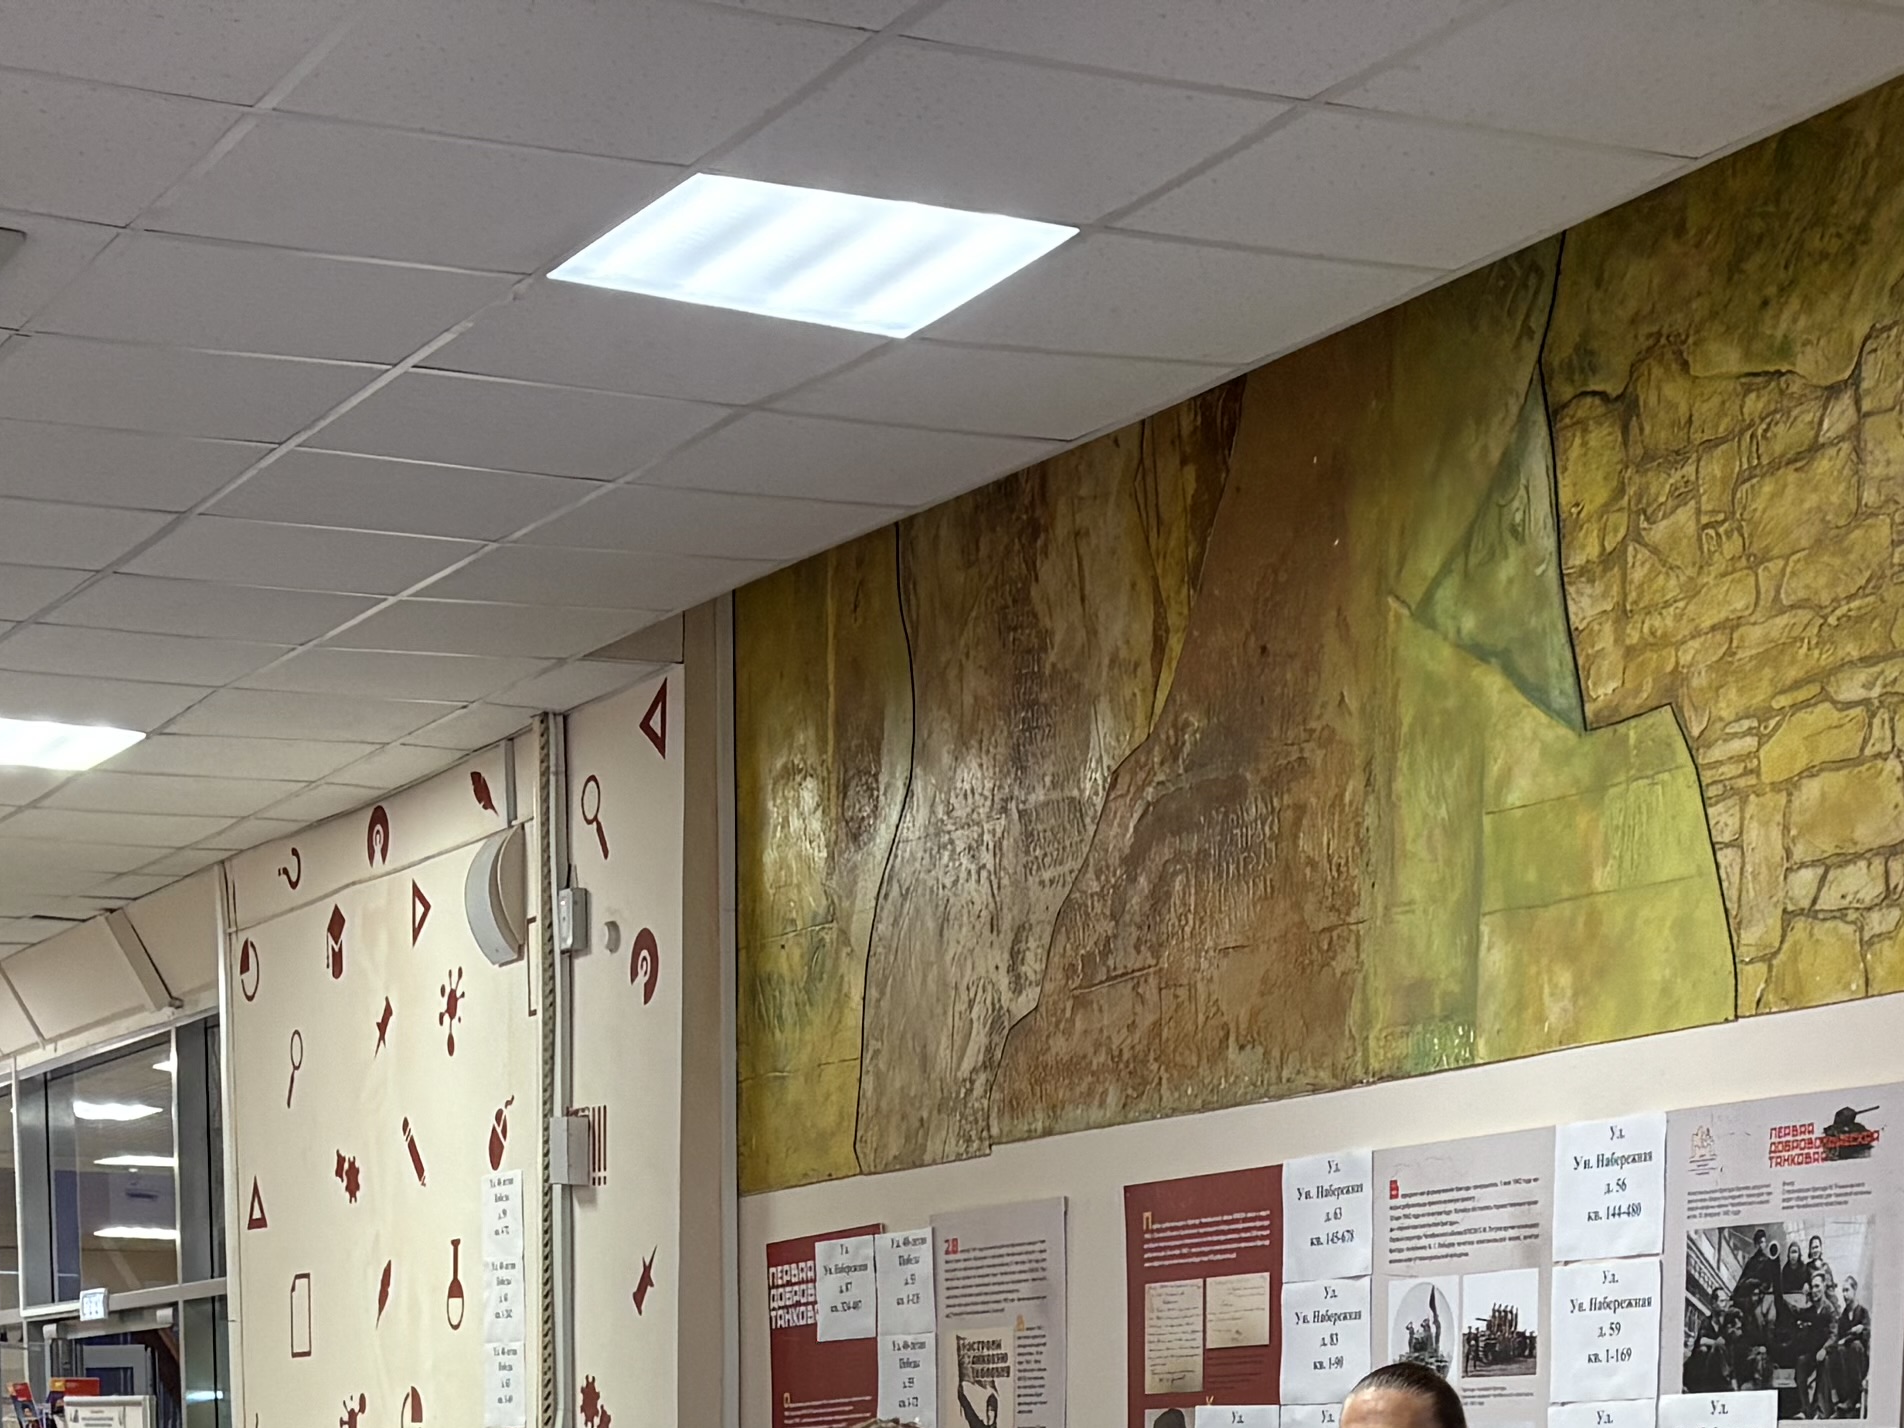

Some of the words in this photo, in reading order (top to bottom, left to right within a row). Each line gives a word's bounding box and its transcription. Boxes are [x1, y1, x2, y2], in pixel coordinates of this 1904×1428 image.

[1770, 1123, 1814, 1139] ПЕРВАЯ
[1597, 1151, 1652, 1170] Набережная
[1589, 1296, 1652, 1313] Набережная
[1609, 1322, 1621, 1336] 59
[1606, 1347, 1632, 1363] 1-169
